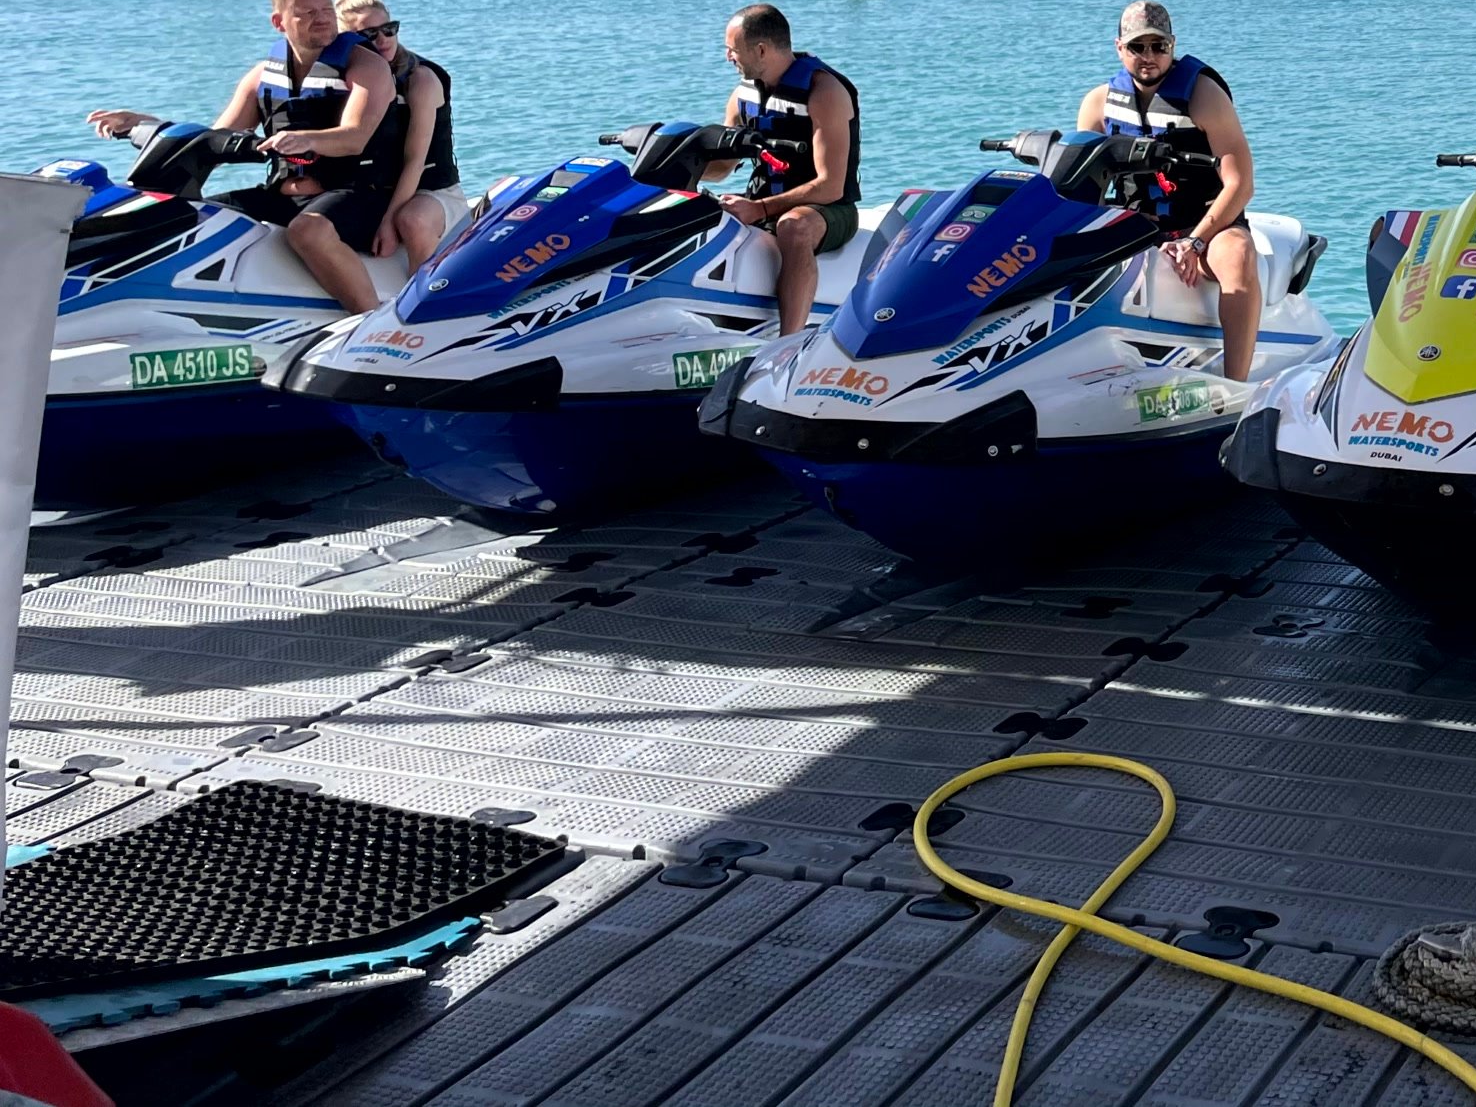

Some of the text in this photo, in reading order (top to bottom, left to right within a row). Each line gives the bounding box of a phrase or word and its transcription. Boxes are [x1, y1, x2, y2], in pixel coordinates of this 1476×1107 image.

[495, 233, 571, 283] NEMO
[966, 244, 1037, 299] NEMO
[362, 330, 425, 350] NEMO
[931, 315, 1012, 365] WATERSPORTS
[134, 346, 250, 386] DA 4510 JS
[676, 355, 706, 386] DA
[799, 365, 889, 396] NEMO
[794, 387, 874, 407] WATERSPORTS
[1351, 410, 1455, 443] NEMO
[1348, 434, 1440, 457] WATERSPORTS
[1370, 451, 1403, 462] DUBAI
